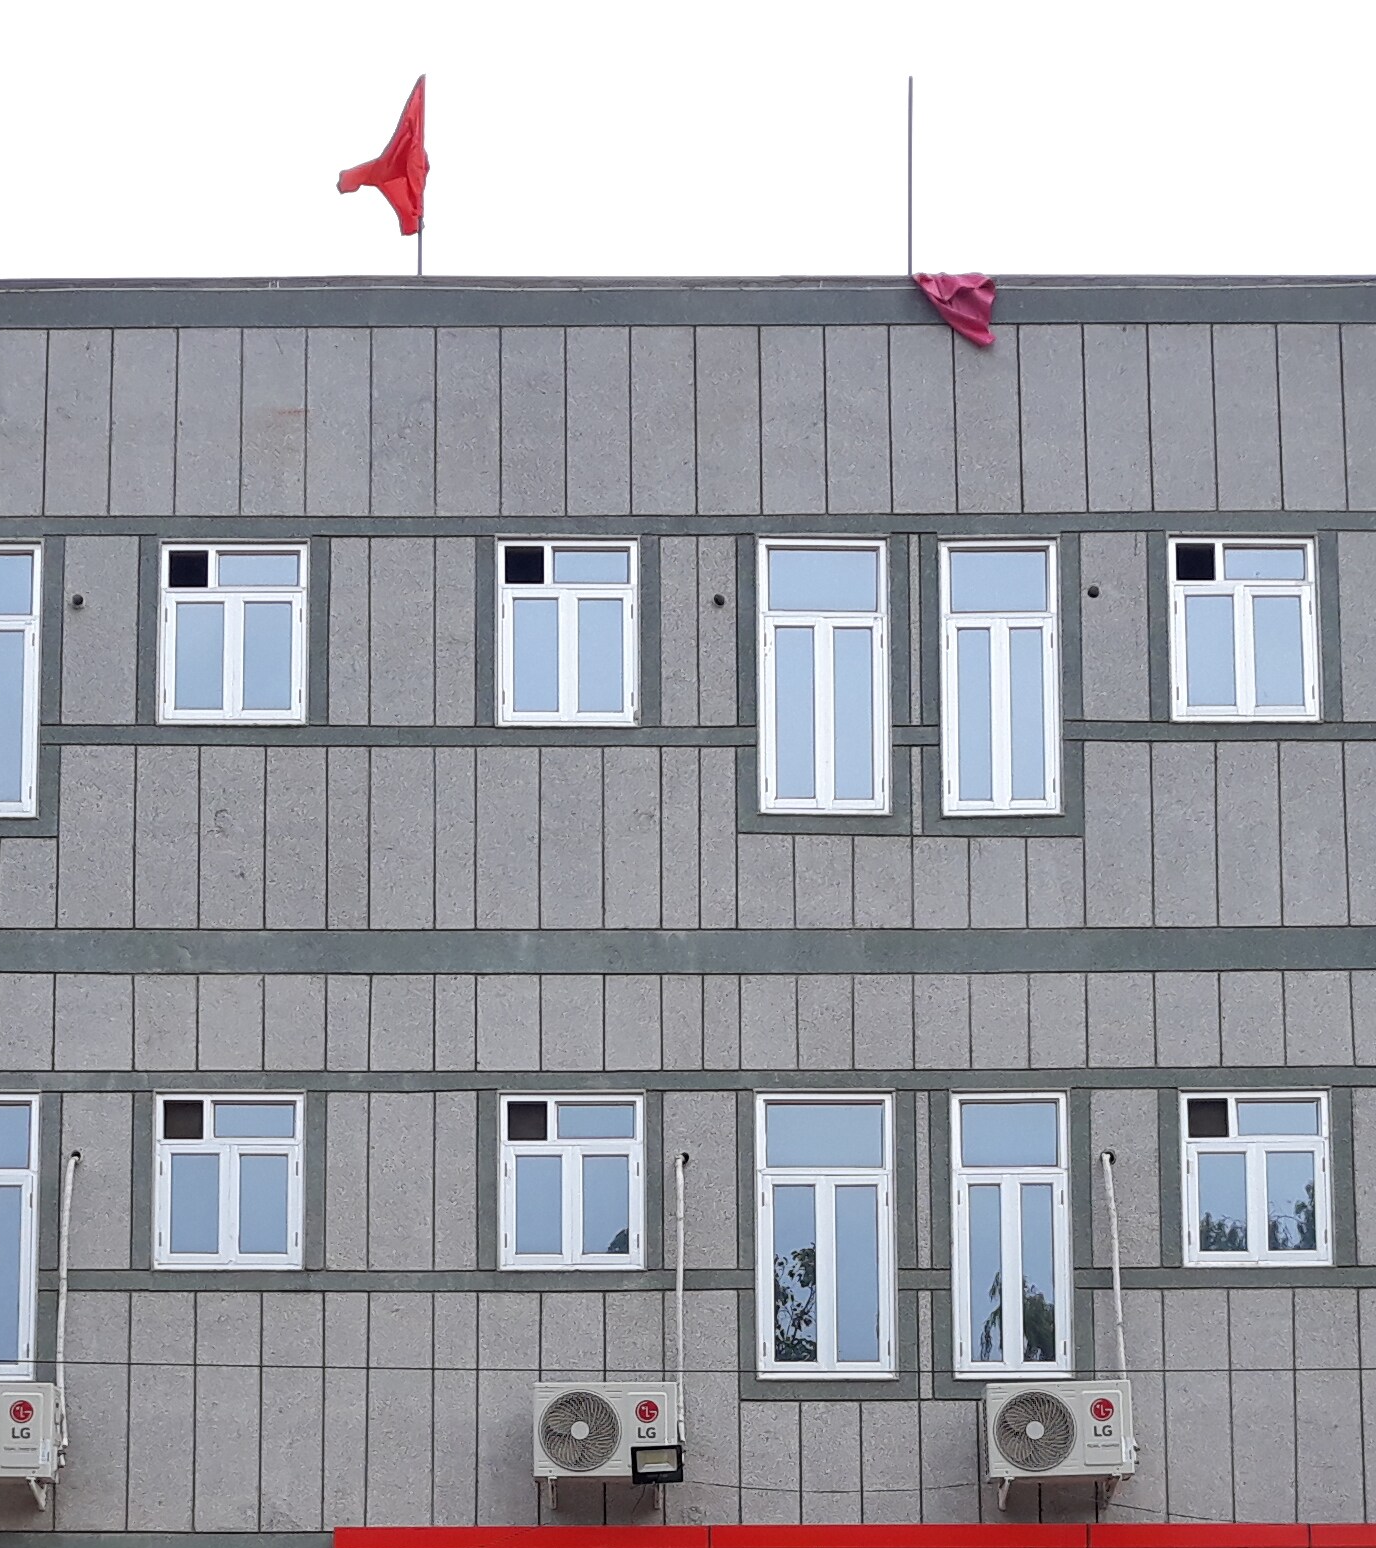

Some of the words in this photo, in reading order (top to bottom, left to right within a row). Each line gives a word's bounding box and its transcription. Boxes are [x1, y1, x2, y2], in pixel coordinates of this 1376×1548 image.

[12, 1427, 30, 1439] LG
[638, 1427, 656, 1438] LG
[1094, 1425, 1112, 1437] LG
